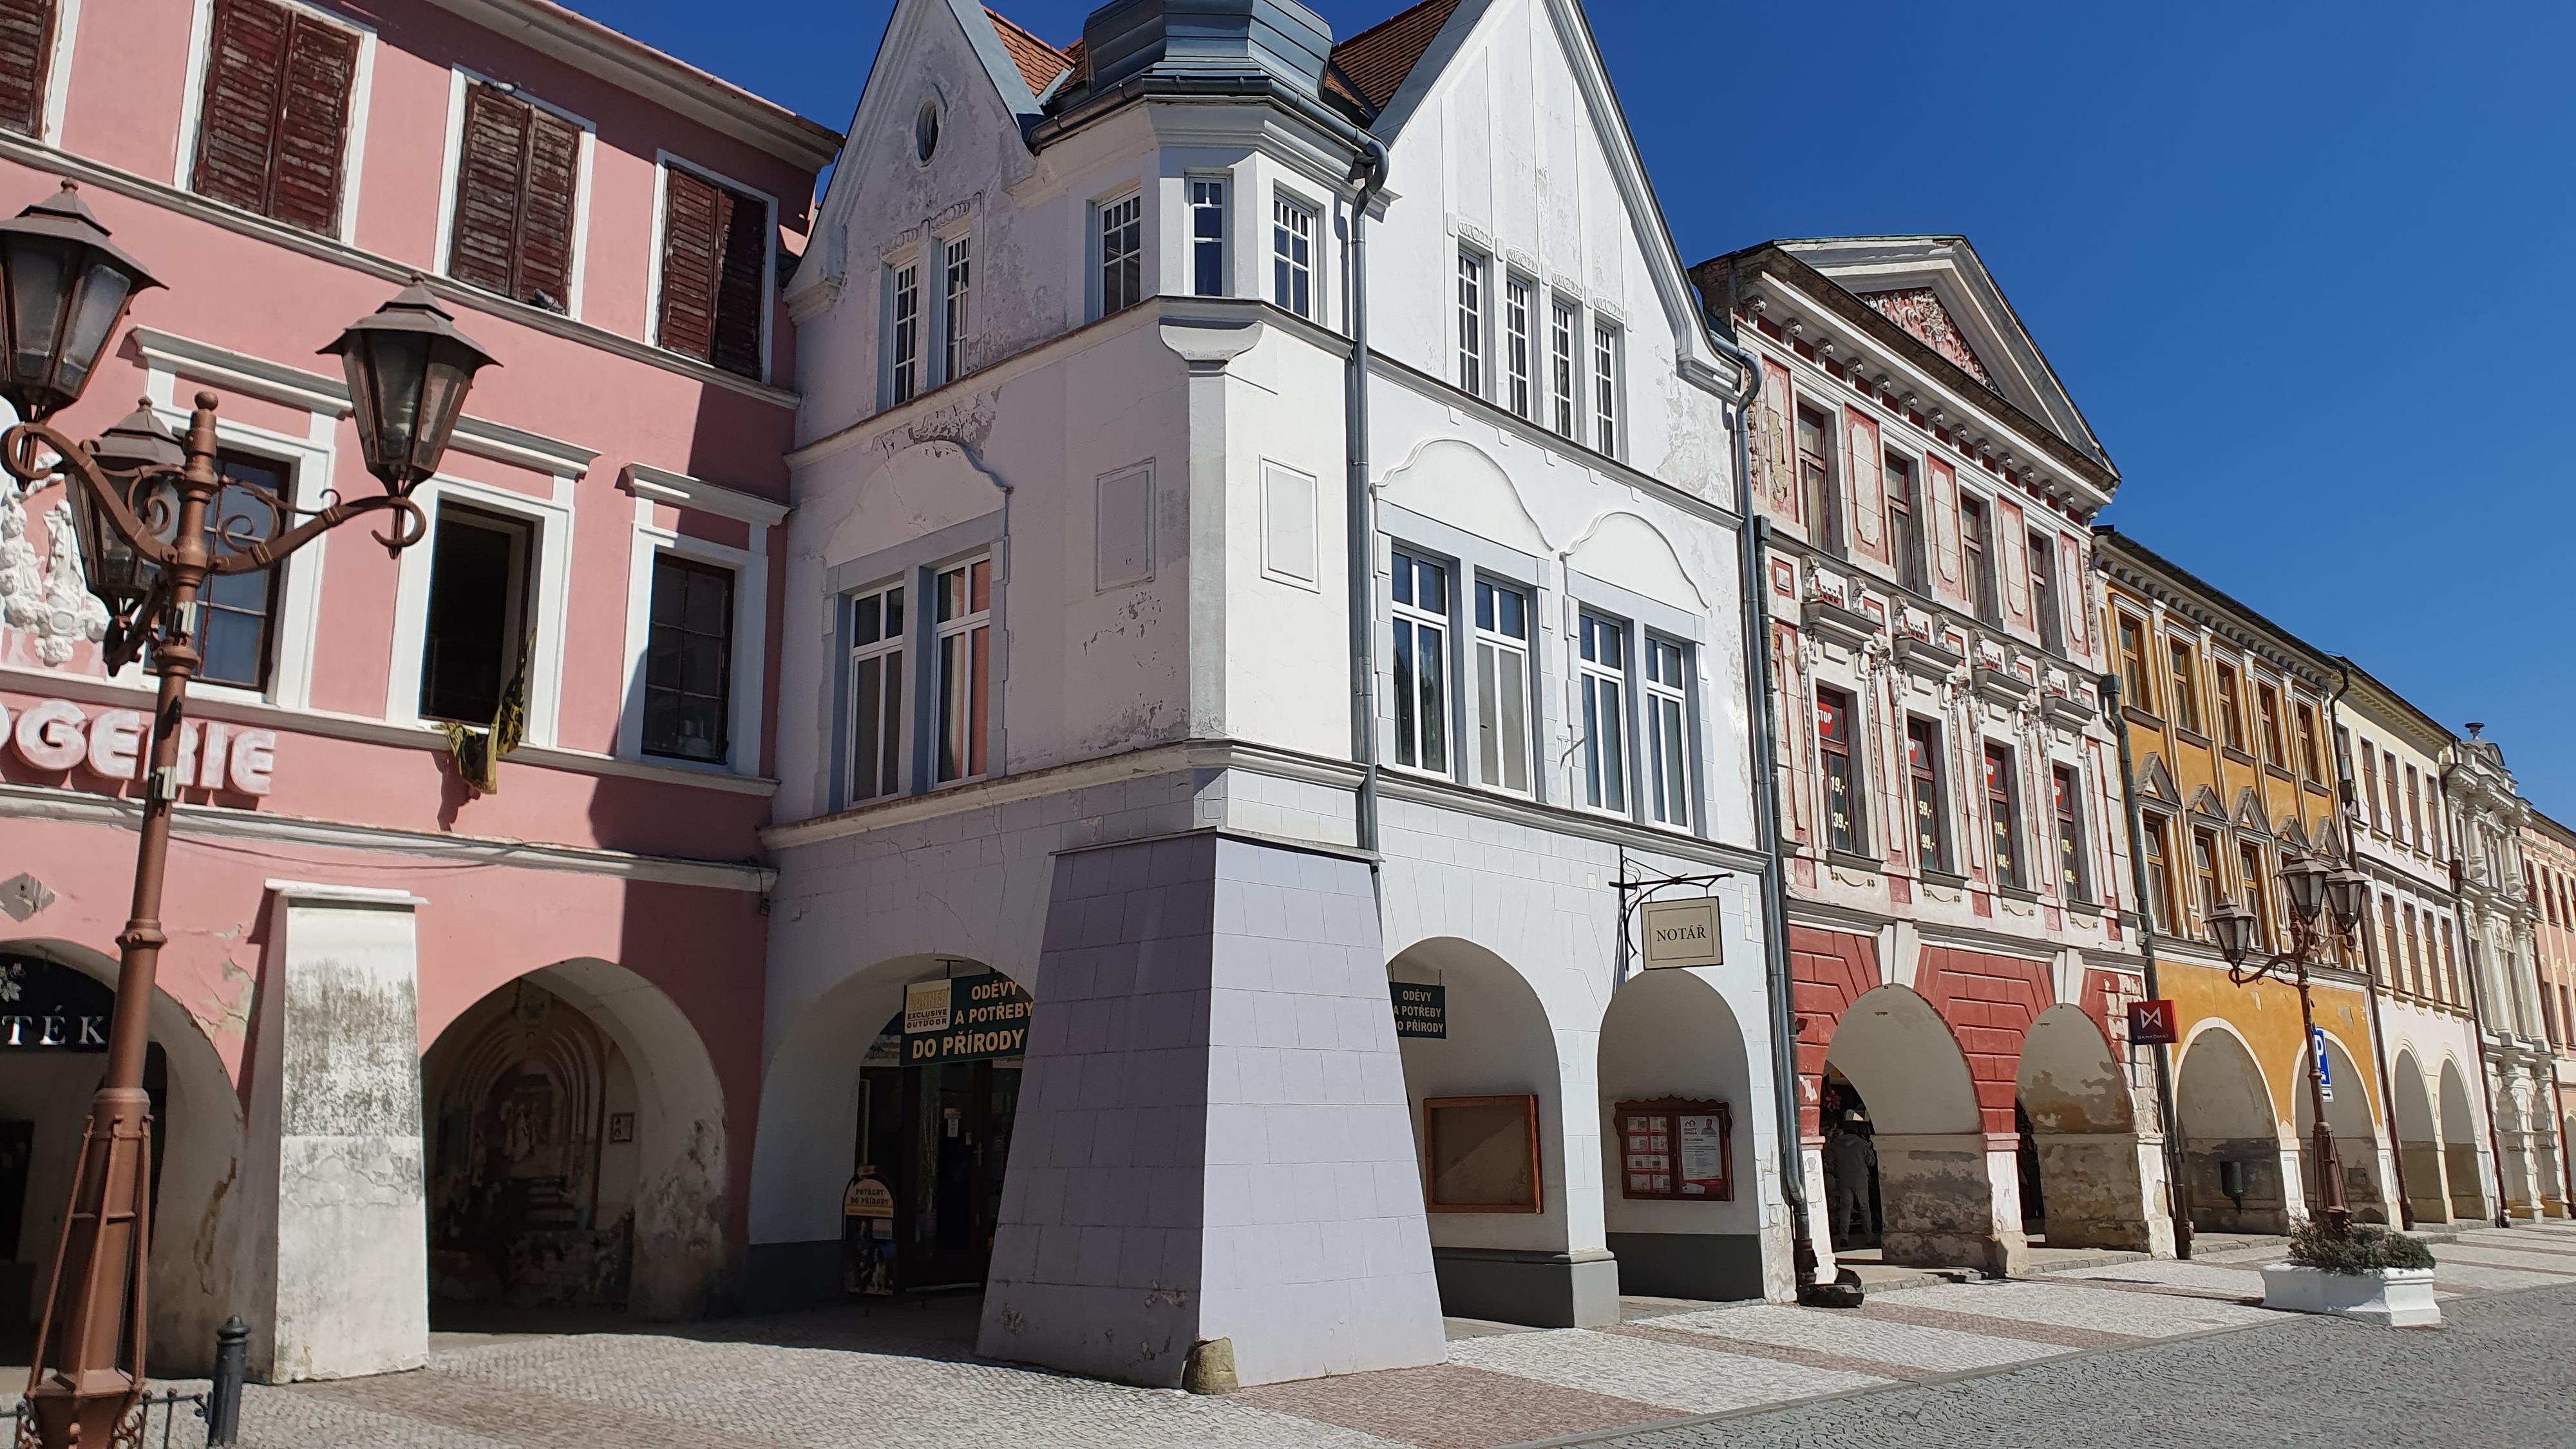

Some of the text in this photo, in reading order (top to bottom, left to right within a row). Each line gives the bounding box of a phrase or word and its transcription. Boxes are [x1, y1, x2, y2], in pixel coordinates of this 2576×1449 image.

[0, 697, 276, 796] GERIE
[1830, 775, 1846, 796] 19,-
[1918, 800, 1933, 820] 59,-
[1833, 812, 1848, 832] 39,-
[1922, 833, 1935, 853] 99,-
[1656, 924, 1707, 942] NOTÁŘ
[972, 980, 1019, 1000] ODĚVY
[1403, 989, 1432, 1002] ODĚVY
[907, 1009, 947, 1020] EXCLUSIVE
[954, 1001, 1034, 1025] A POTŘEBY
[1394, 1004, 1441, 1018] A POTŘEBY
[907, 1018, 947, 1028] OUTDOOR
[1406, 1019, 1444, 1034] PŘÍRODY
[912, 1038, 937, 1059] DO
[942, 1028, 1025, 1057] PŘÍRODY
